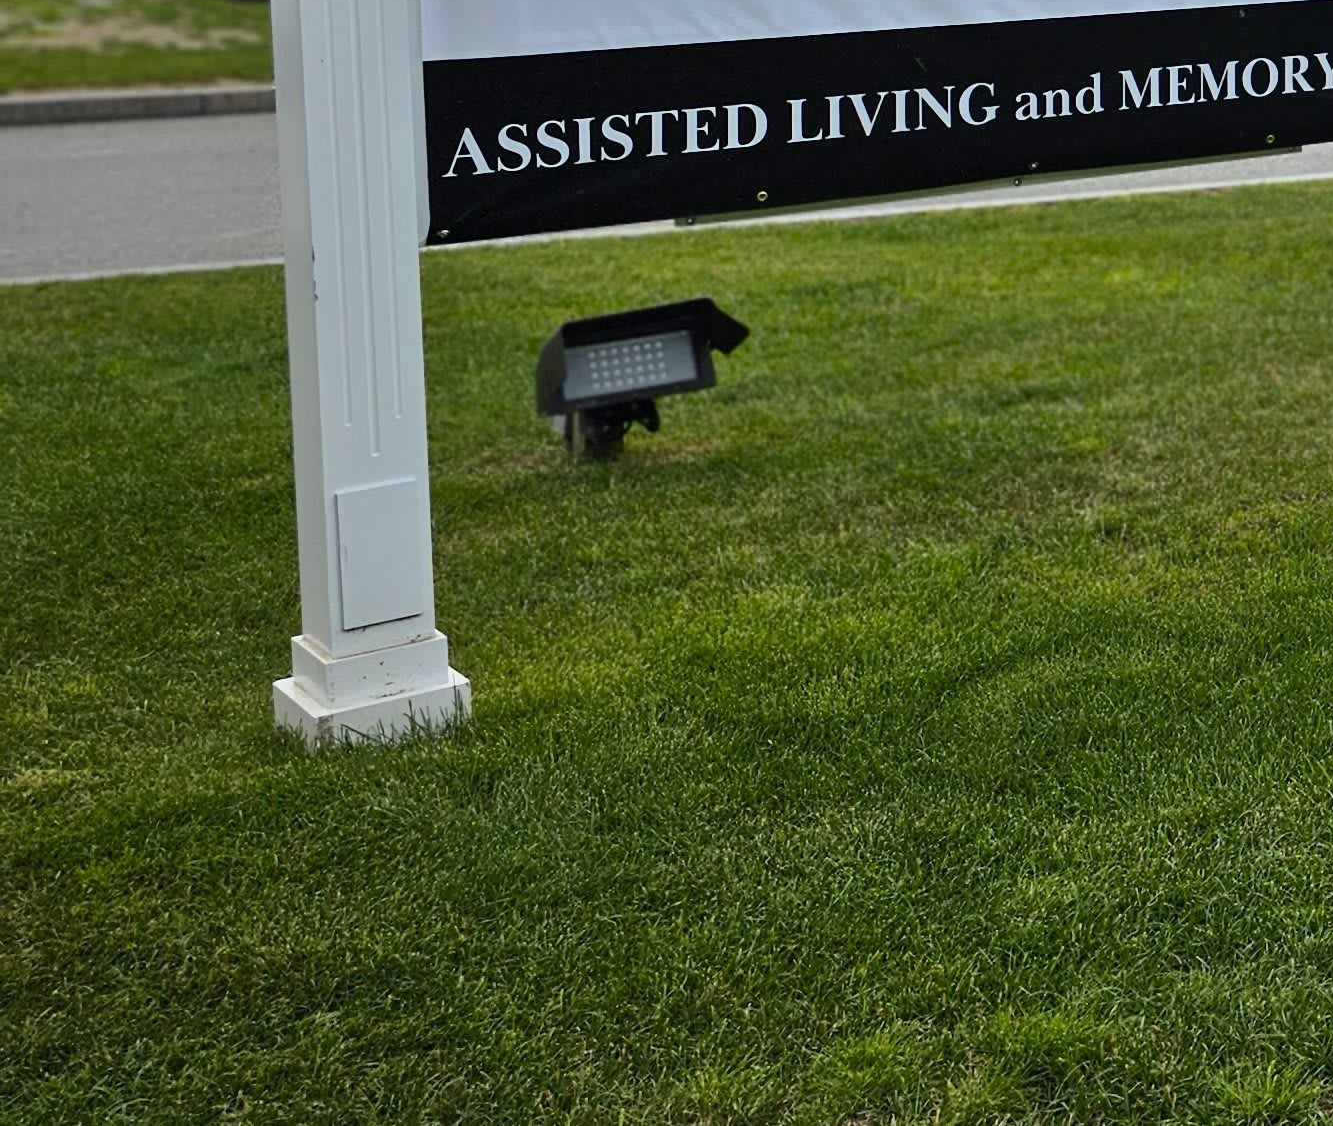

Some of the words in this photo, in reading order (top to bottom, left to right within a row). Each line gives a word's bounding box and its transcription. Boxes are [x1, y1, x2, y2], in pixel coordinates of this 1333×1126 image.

[441, 103, 768, 178] ASSISTED
[786, 81, 1001, 144] LIVING
[1015, 71, 1105, 121] and
